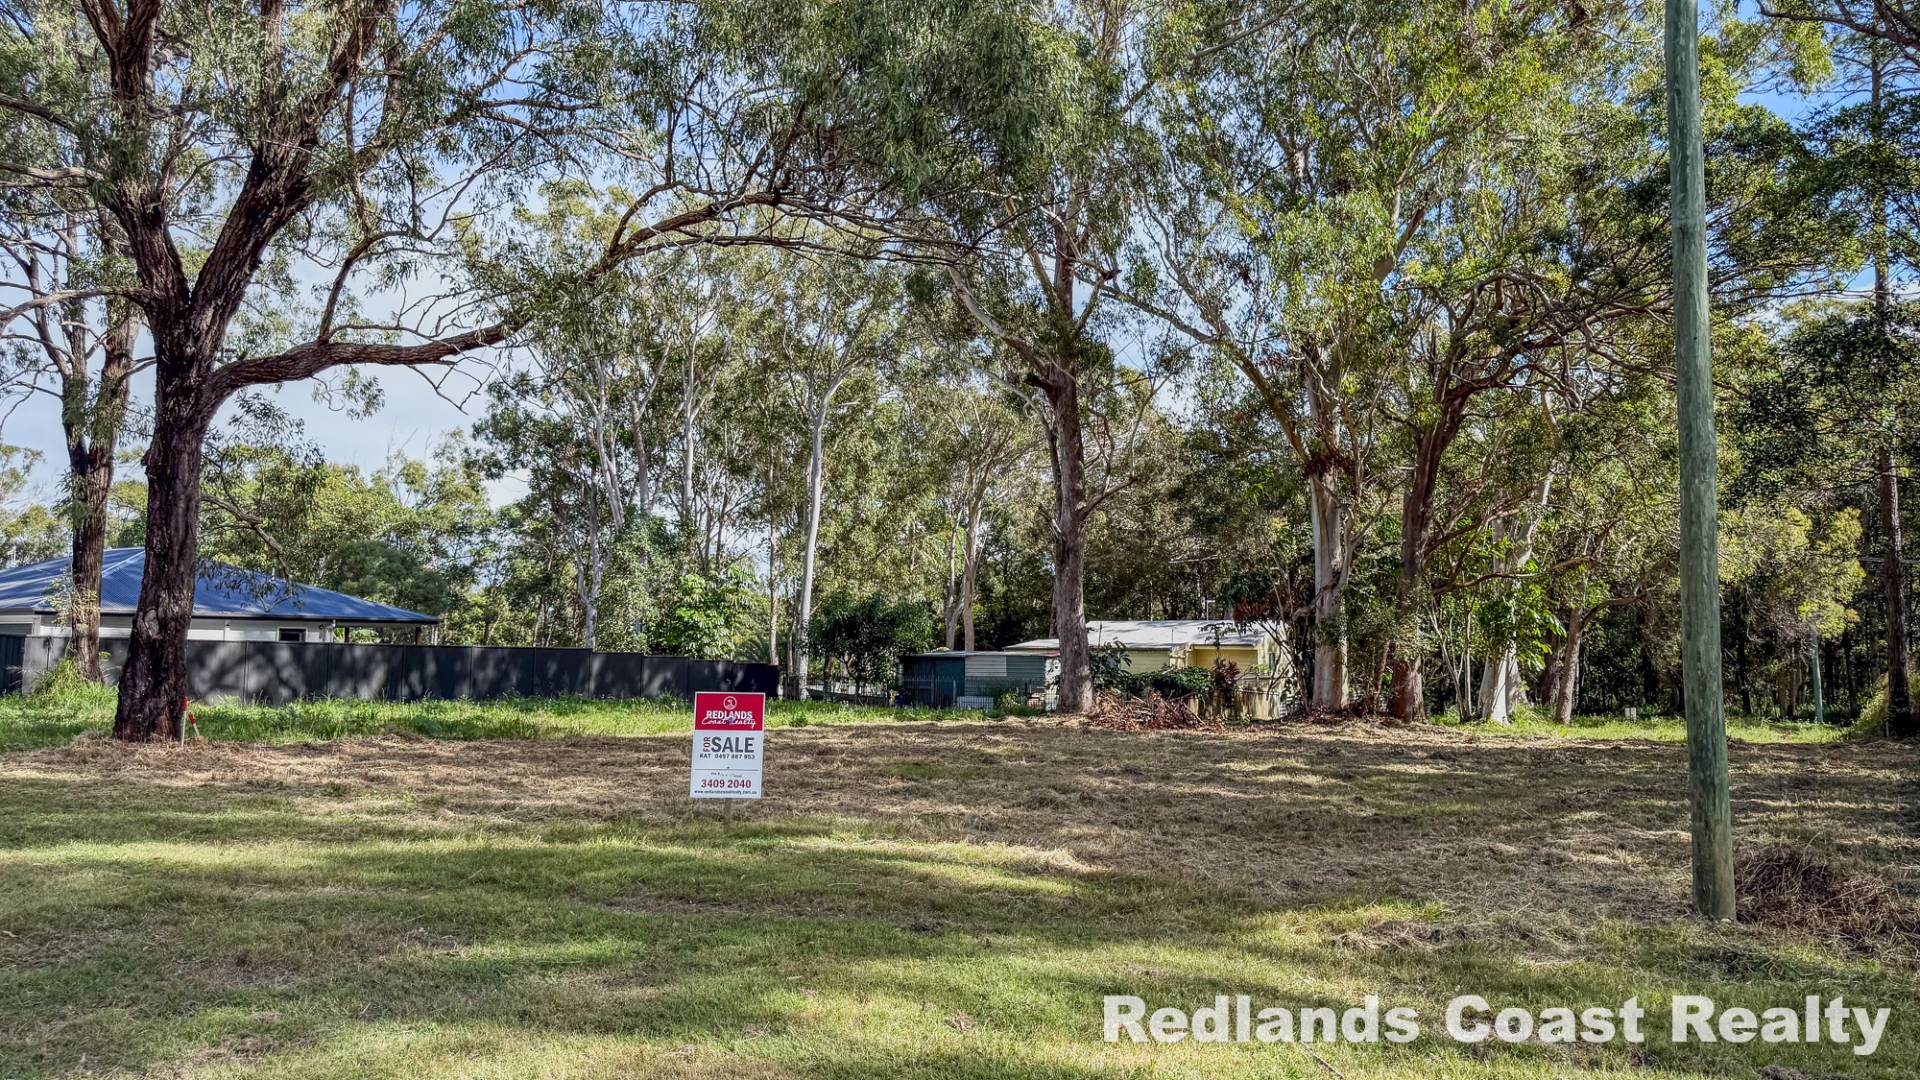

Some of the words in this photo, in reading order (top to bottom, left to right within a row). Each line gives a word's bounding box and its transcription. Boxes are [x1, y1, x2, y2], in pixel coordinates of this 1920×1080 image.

[706, 710, 753, 719] REDLANDS
[701, 716, 727, 725] Coast
[703, 736, 711, 752] FOR
[711, 736, 755, 753] SALE
[701, 779, 725, 789] 3409
[727, 779, 752, 789] 2040
